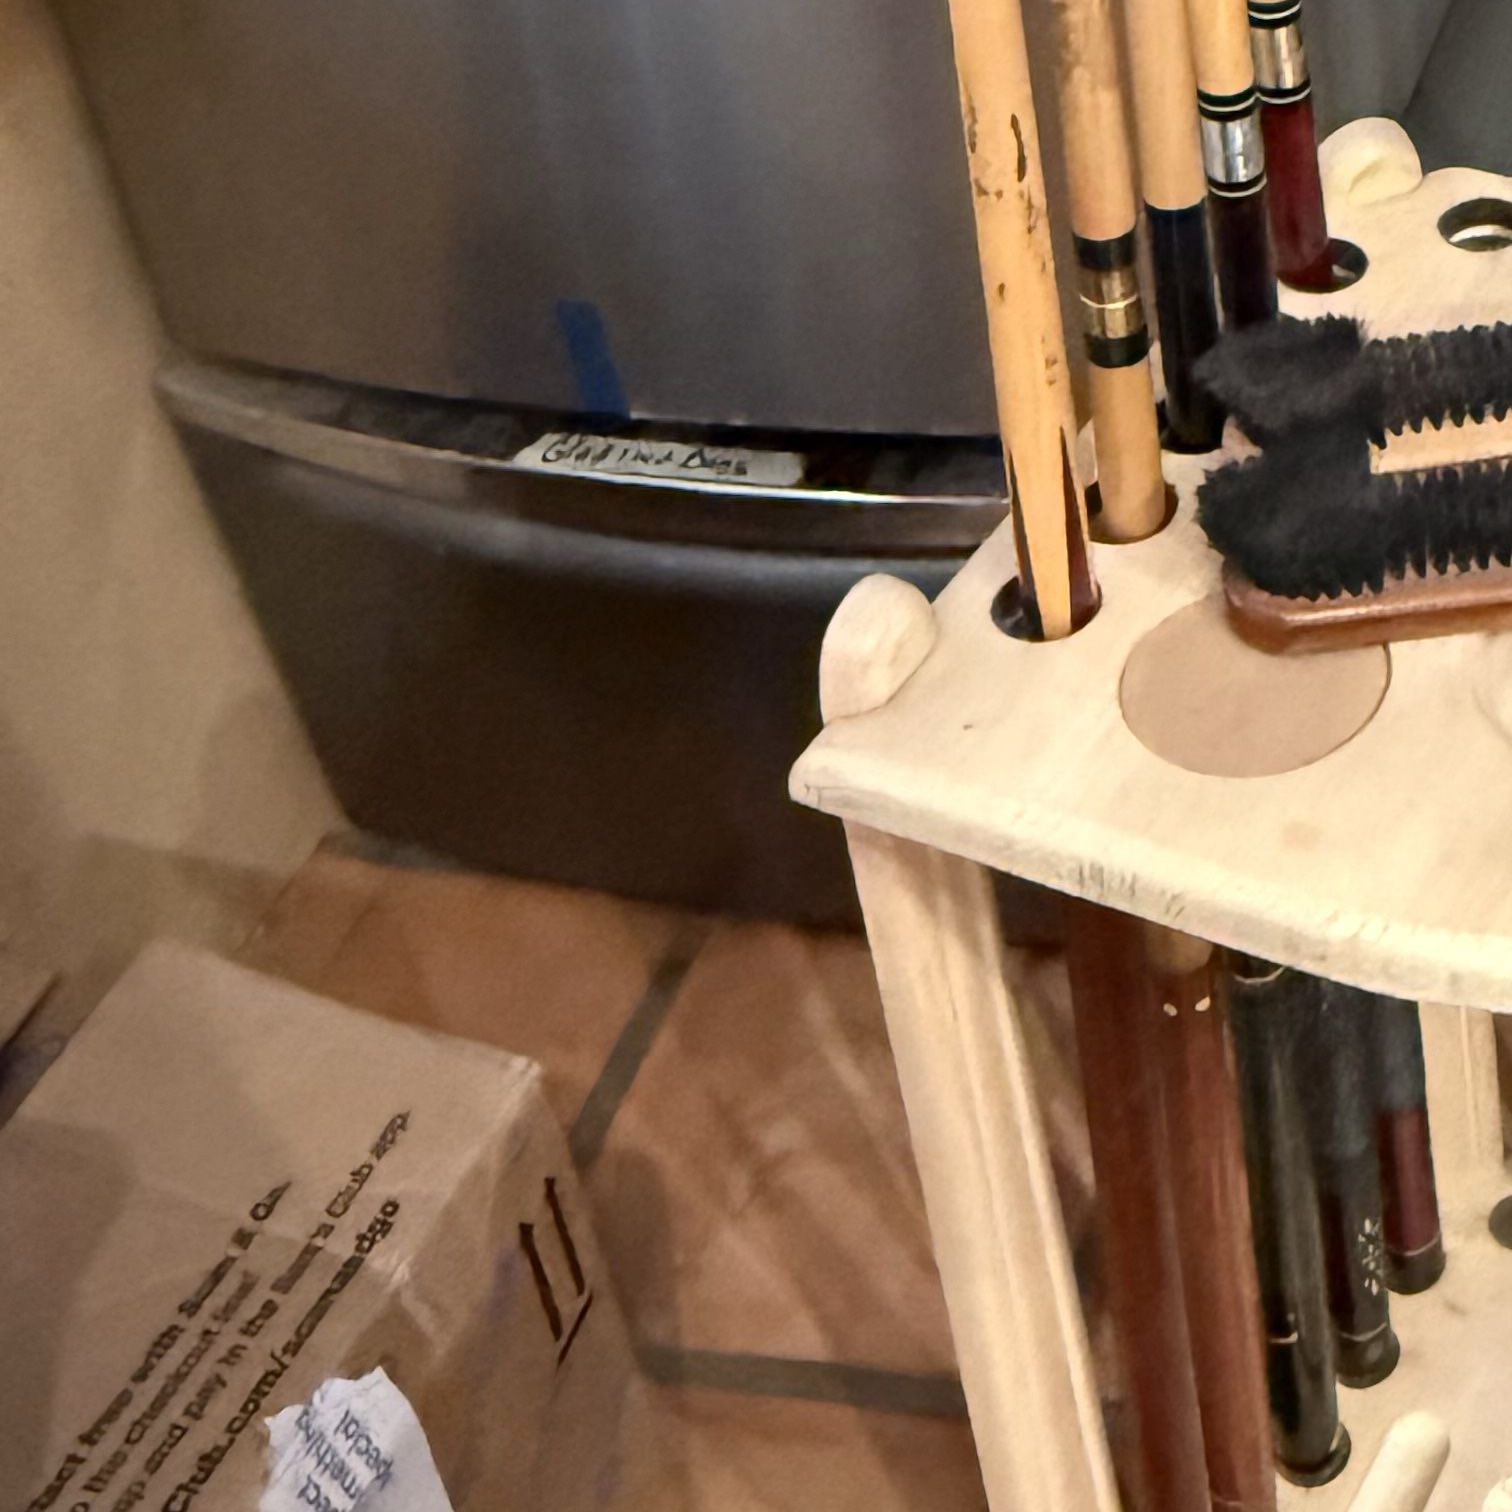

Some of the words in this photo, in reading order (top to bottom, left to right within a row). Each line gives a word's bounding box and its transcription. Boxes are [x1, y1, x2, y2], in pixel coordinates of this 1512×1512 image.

[84, 1449, 128, 1494] the
[124, 1328, 219, 1446] checkout
[144, 1423, 189, 1476] and
[184, 1374, 229, 1425] pay
[239, 1297, 280, 1340] the
[325, 1160, 374, 1219] Club
